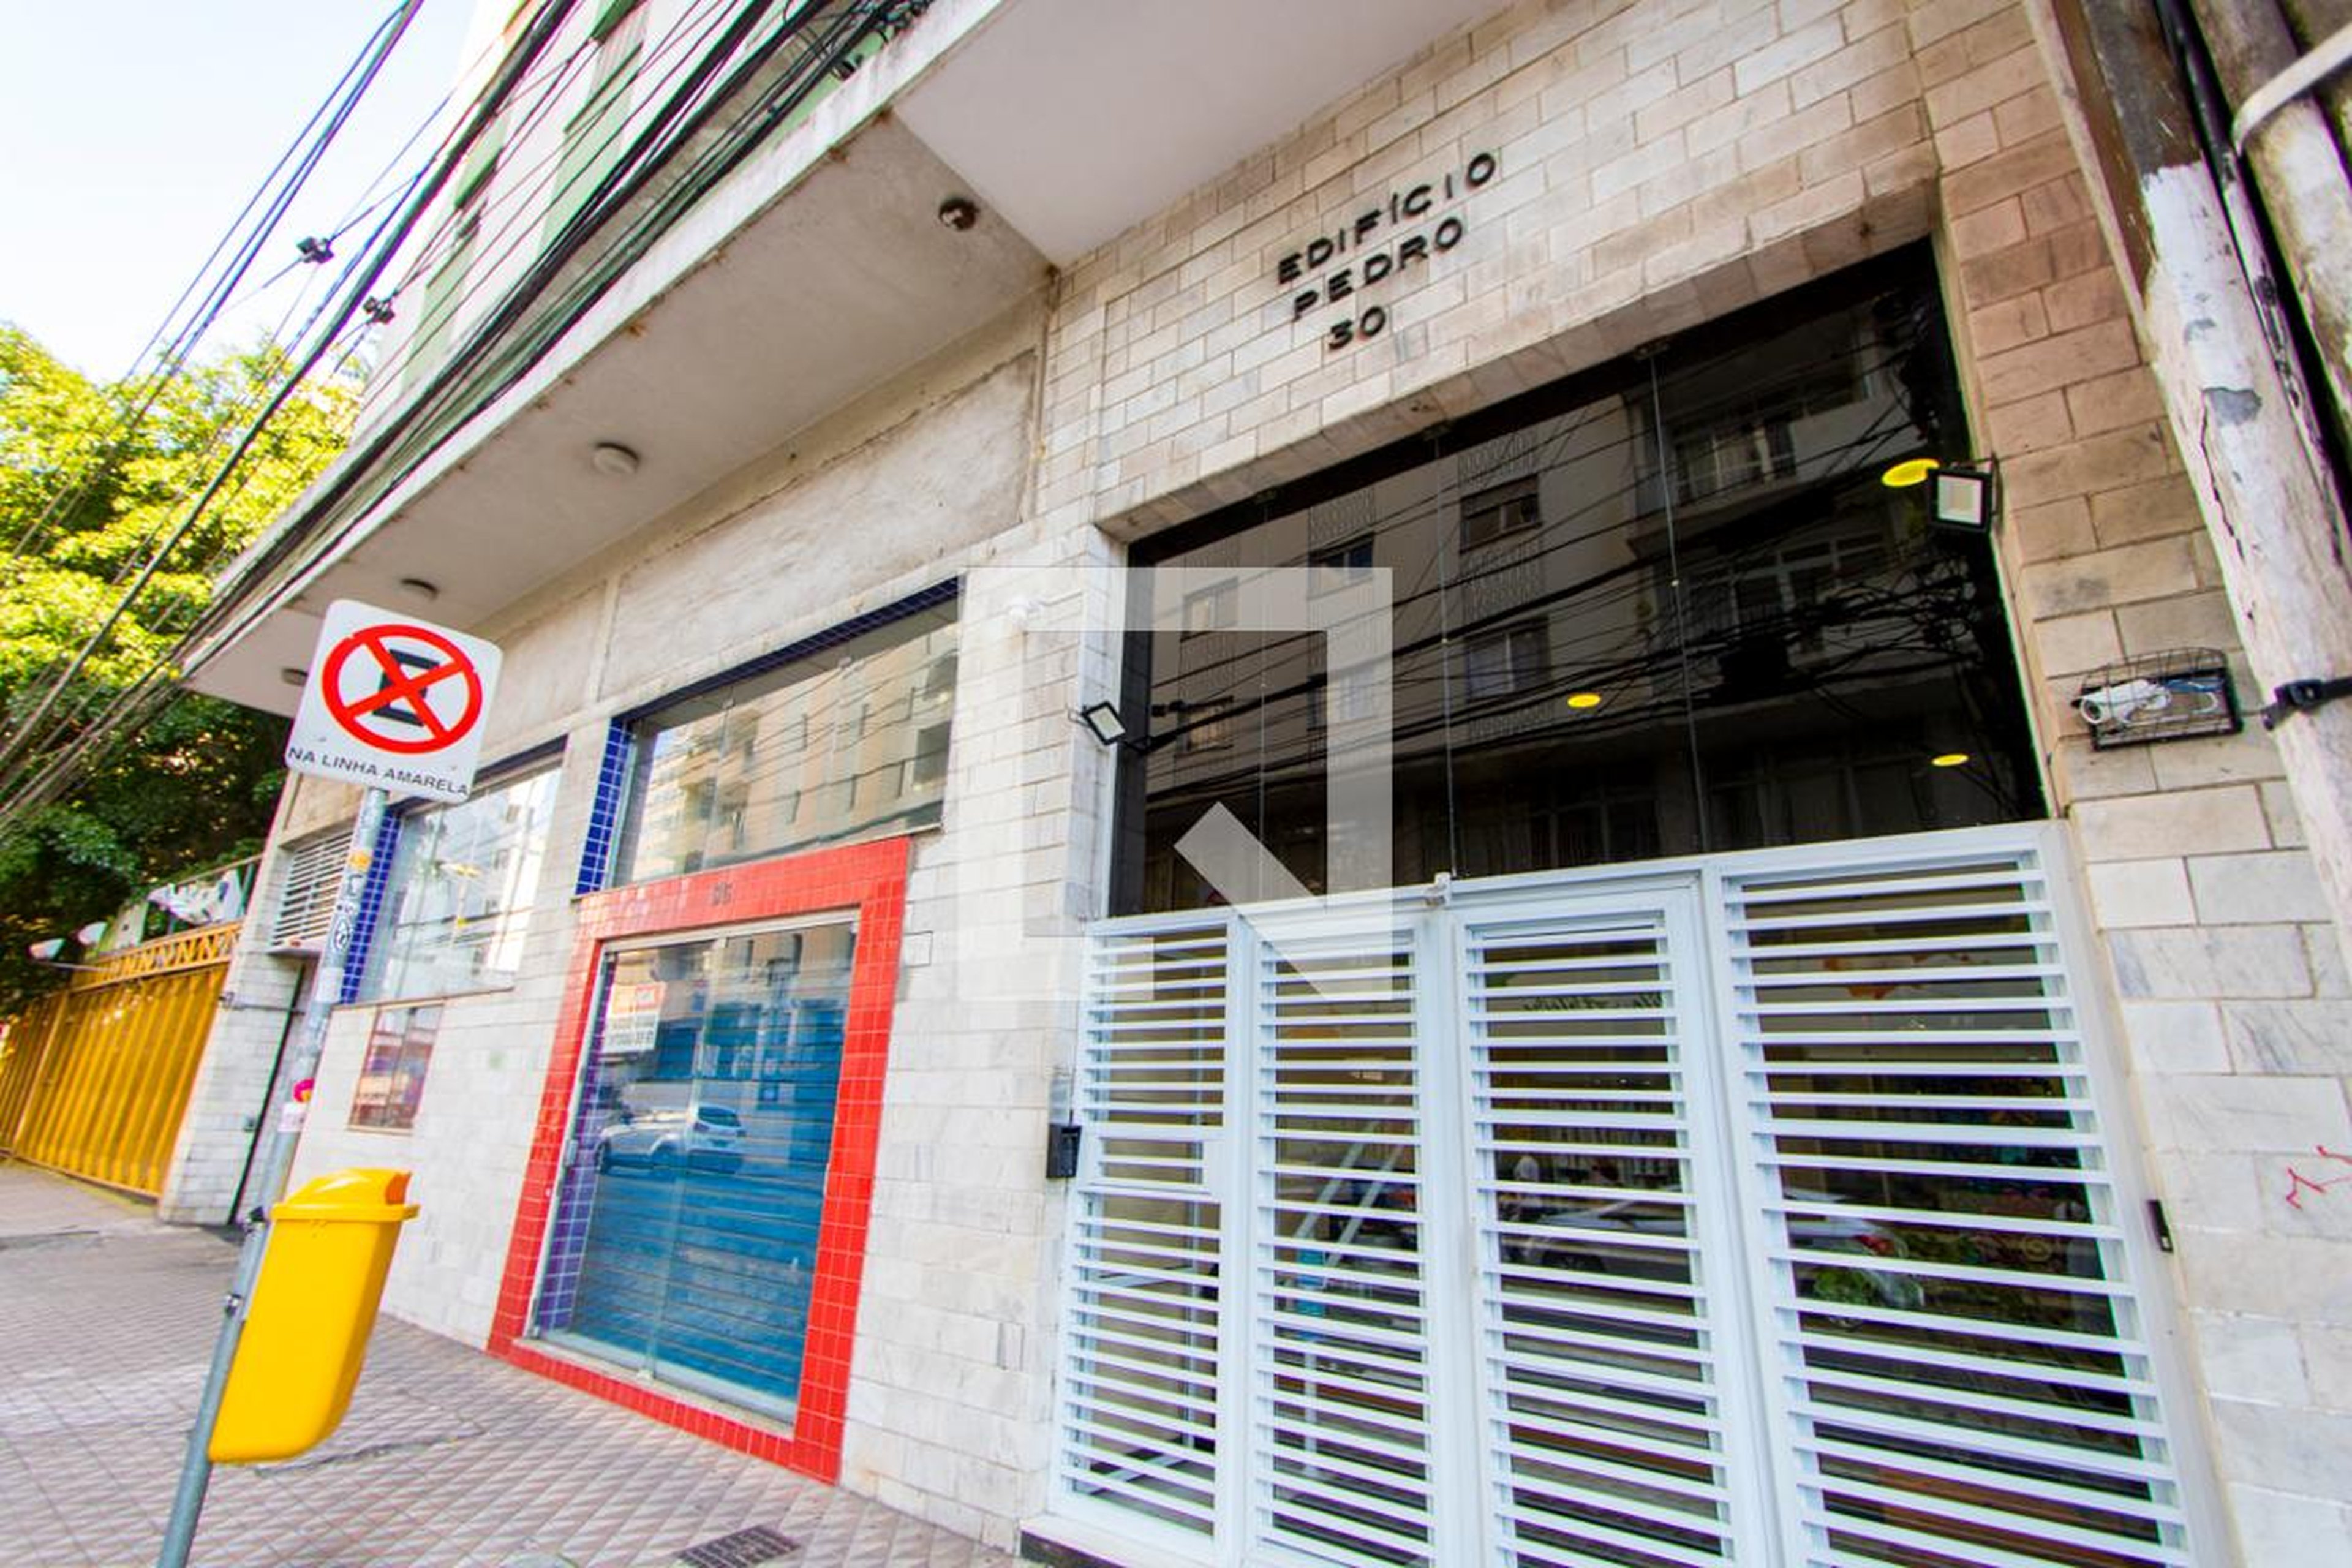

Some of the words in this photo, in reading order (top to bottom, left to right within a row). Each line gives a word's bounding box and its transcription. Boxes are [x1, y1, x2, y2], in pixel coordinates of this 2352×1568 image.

[1292, 217, 1463, 322] PEDRO
[1328, 306, 1386, 350] 30
[288, 747, 316, 764] NA
[322, 755, 378, 776] LINHA
[383, 767, 469, 795] AMARELA
